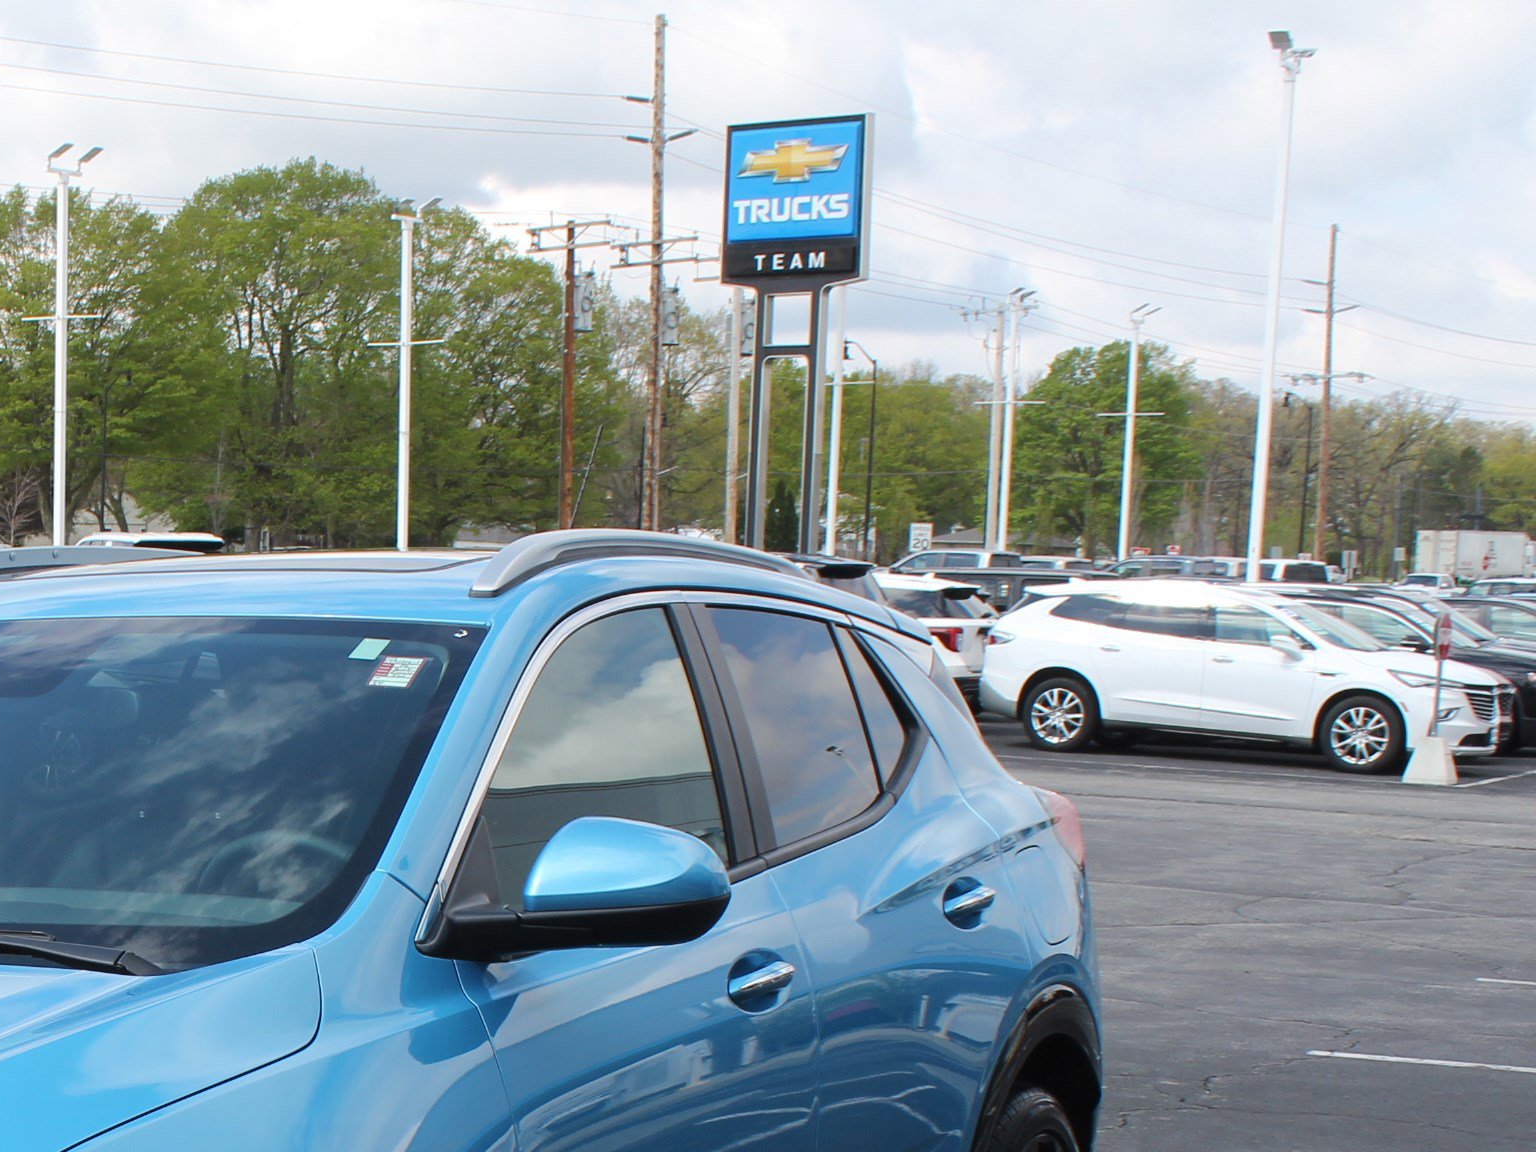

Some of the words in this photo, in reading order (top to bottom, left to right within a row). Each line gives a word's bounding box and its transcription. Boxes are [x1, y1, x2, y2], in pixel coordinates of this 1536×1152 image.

[732, 193, 850, 225] TRUCKS
[754, 251, 826, 272] TEAM
[912, 538, 930, 550] 20
